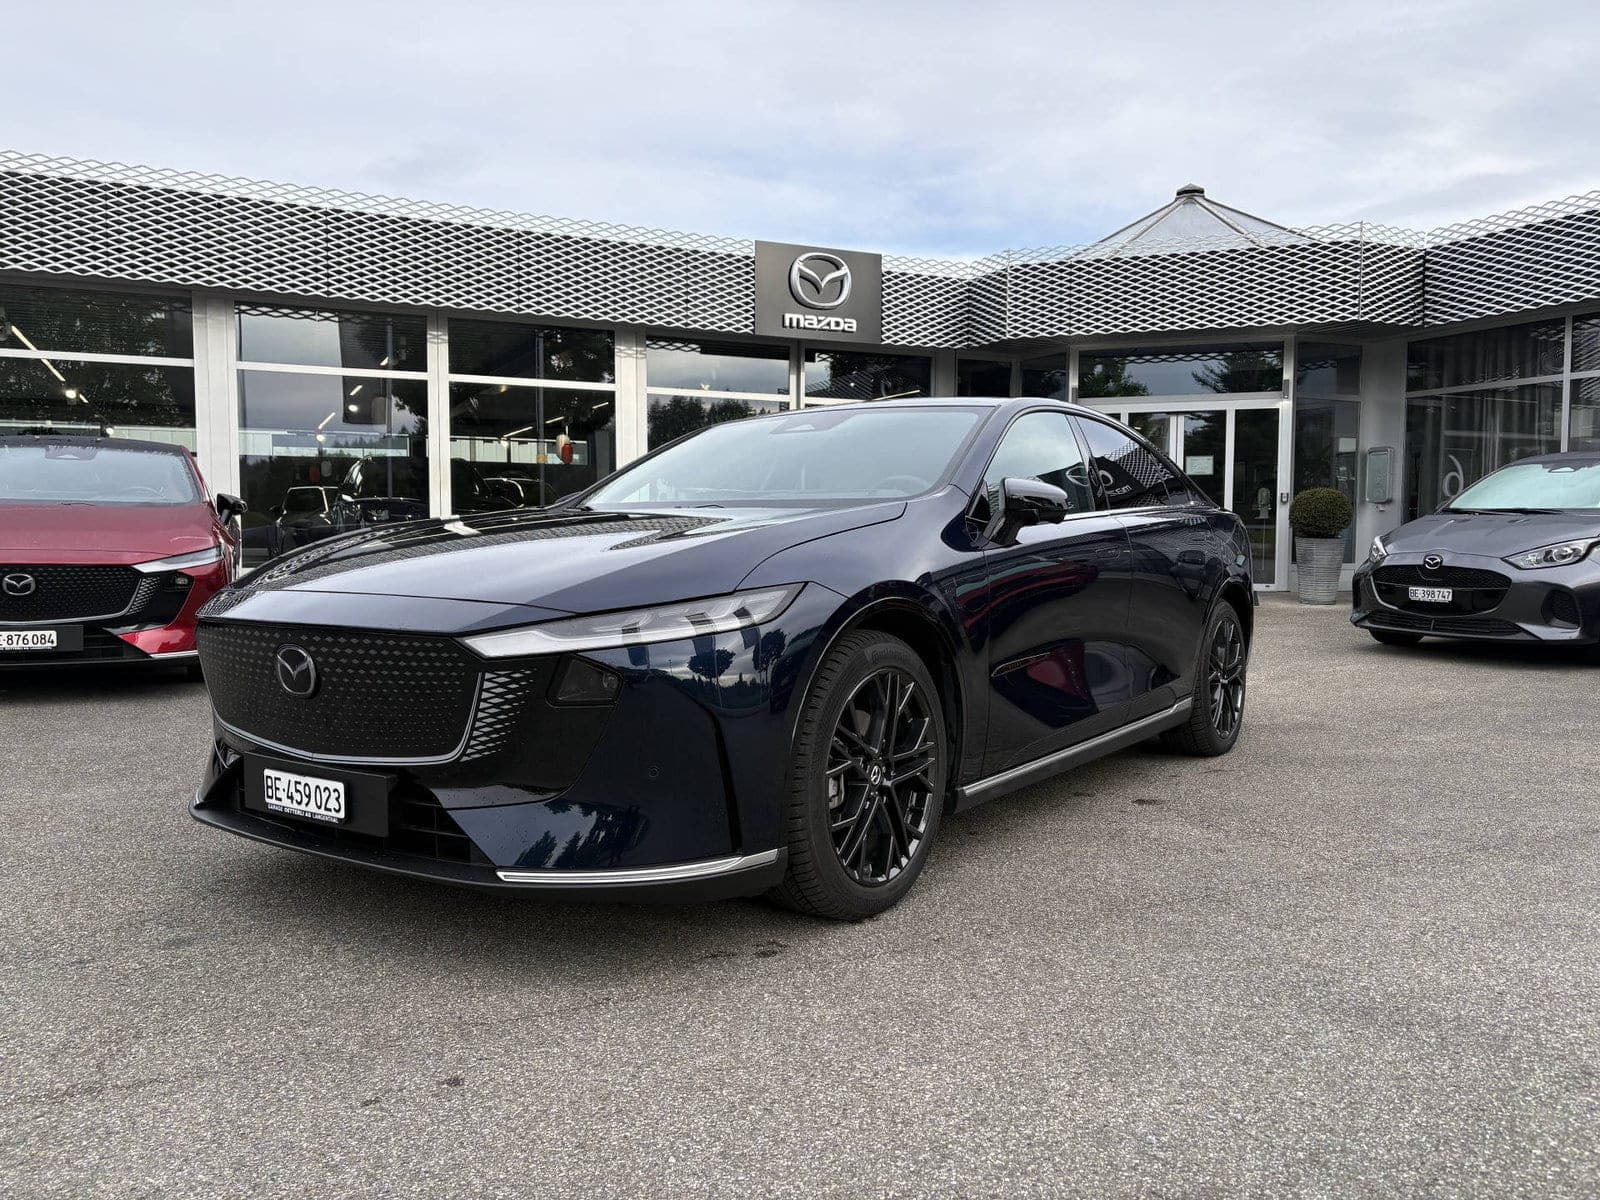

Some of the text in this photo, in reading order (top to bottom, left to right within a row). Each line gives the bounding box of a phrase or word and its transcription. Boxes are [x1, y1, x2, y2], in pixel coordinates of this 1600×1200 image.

[783, 313, 857, 332] mazda
[31, 633, 55, 646] 084
[314, 784, 342, 813] 023
